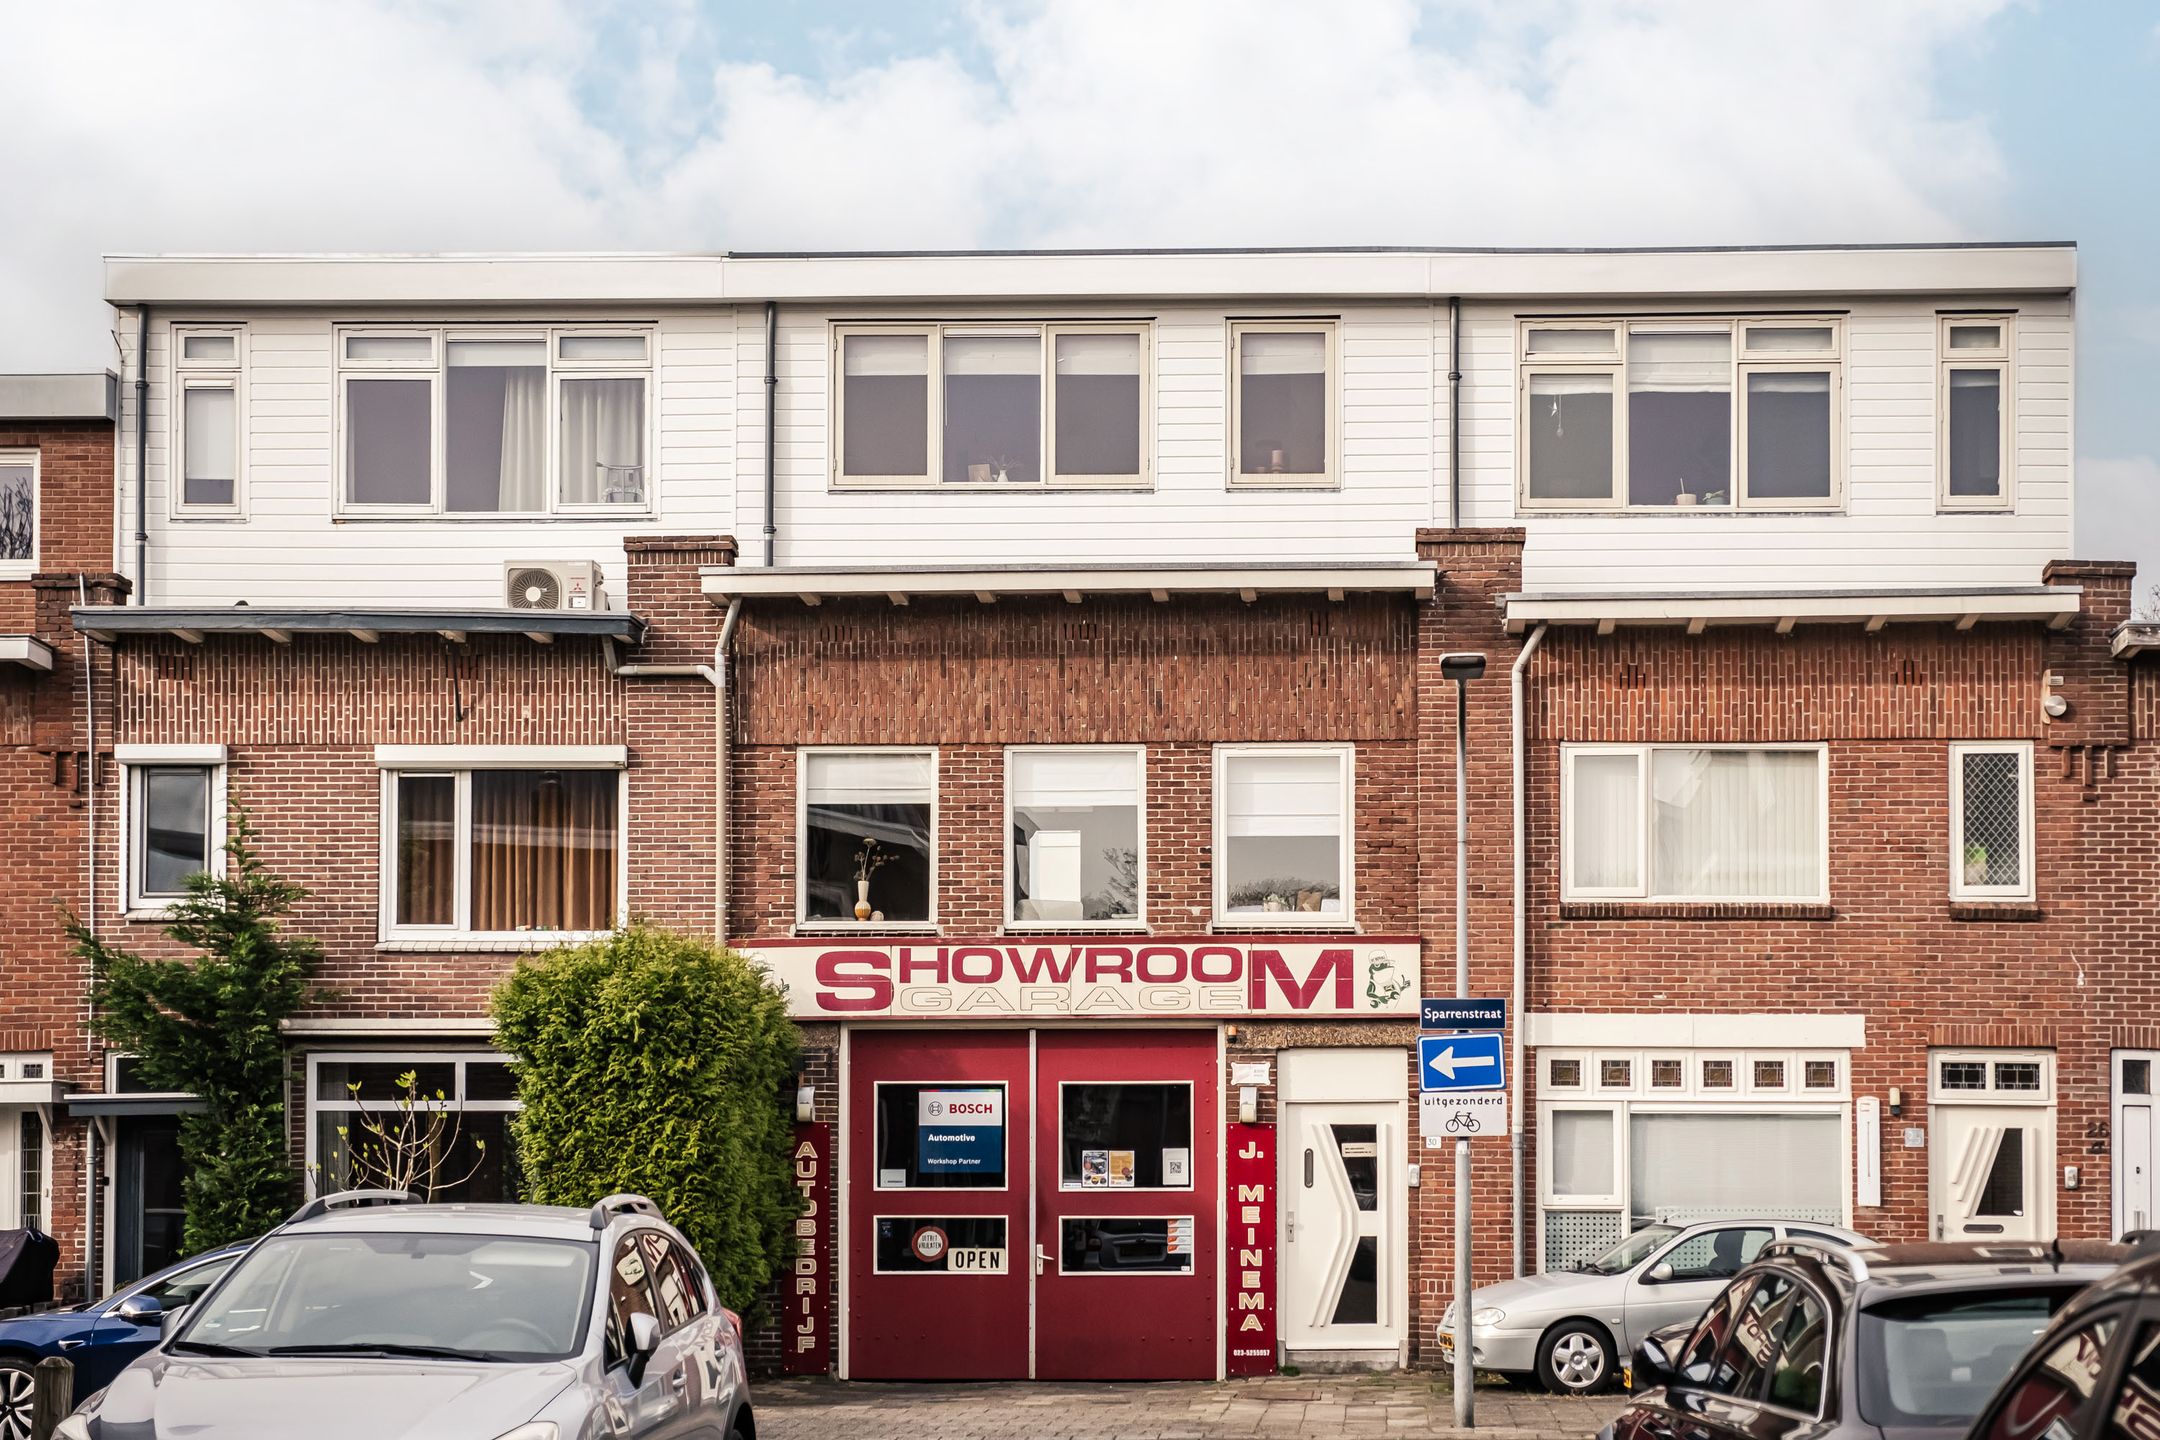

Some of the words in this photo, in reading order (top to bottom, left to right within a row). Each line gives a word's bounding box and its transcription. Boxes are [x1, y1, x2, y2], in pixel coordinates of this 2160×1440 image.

[815, 947, 1354, 1012] SHOWROOM
[900, 985, 1244, 1012] GARAGE
[1424, 1008, 1502, 1022] Sparrenstraat
[949, 1103, 993, 1114] BOSCH
[1424, 1096, 1503, 1108] uitgezonderd
[928, 1134, 976, 1142] Automotive
[2087, 1122, 2110, 1138] 26
[1238, 1141, 1264, 1159] J.
[795, 1141, 818, 1353] AUTOBEDRIJF
[955, 1250, 1000, 1269] OPEN
[1238, 1184, 1265, 1332] MEINEMA
